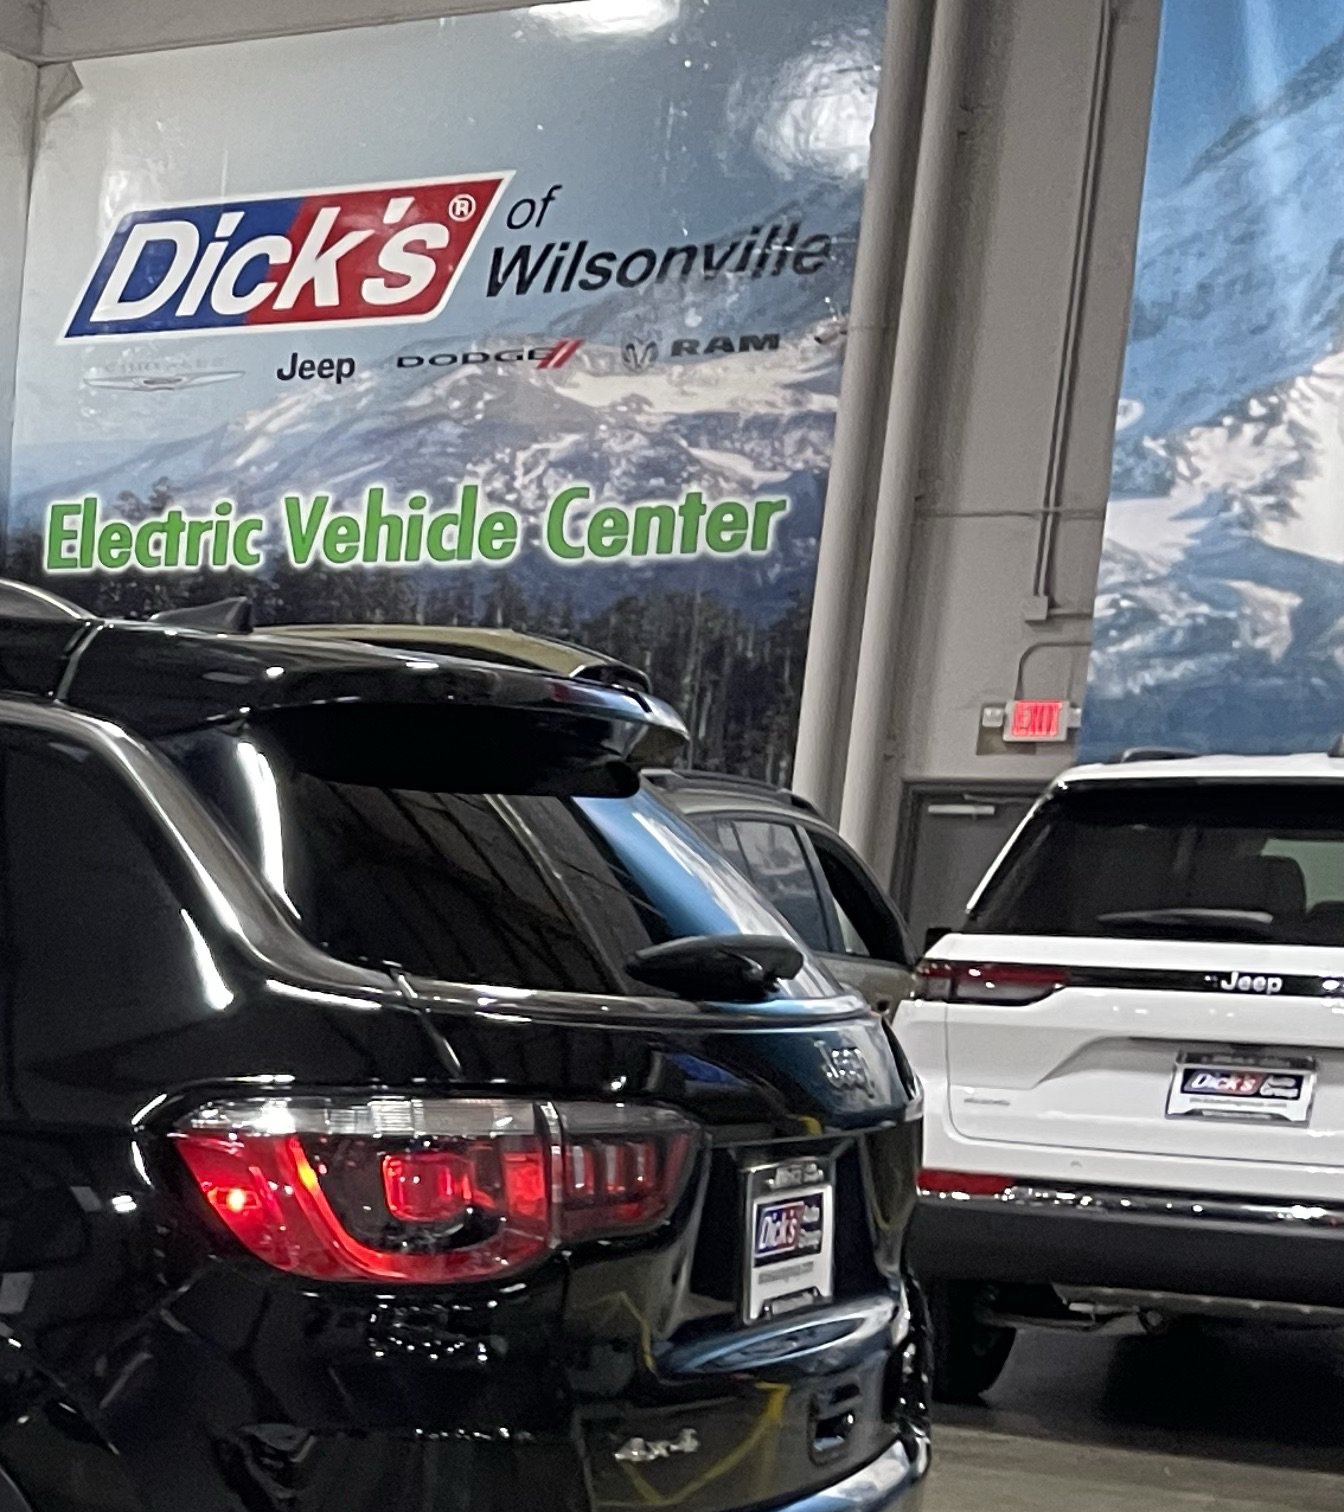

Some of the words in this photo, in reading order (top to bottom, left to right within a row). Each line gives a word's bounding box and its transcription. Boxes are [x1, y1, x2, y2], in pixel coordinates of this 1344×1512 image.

[506, 185, 562, 229] of
[90, 198, 450, 322] Dick's
[486, 222, 832, 297] Wilsonville
[277, 352, 355, 384] Jeep
[397, 346, 549, 368] DODGE
[670, 333, 781, 357] RAM
[47, 497, 263, 569] Electric
[284, 485, 517, 564] Vehicle
[547, 487, 787, 559] Center
[1015, 704, 1059, 735] EXIT
[1220, 971, 1283, 995] Jeep
